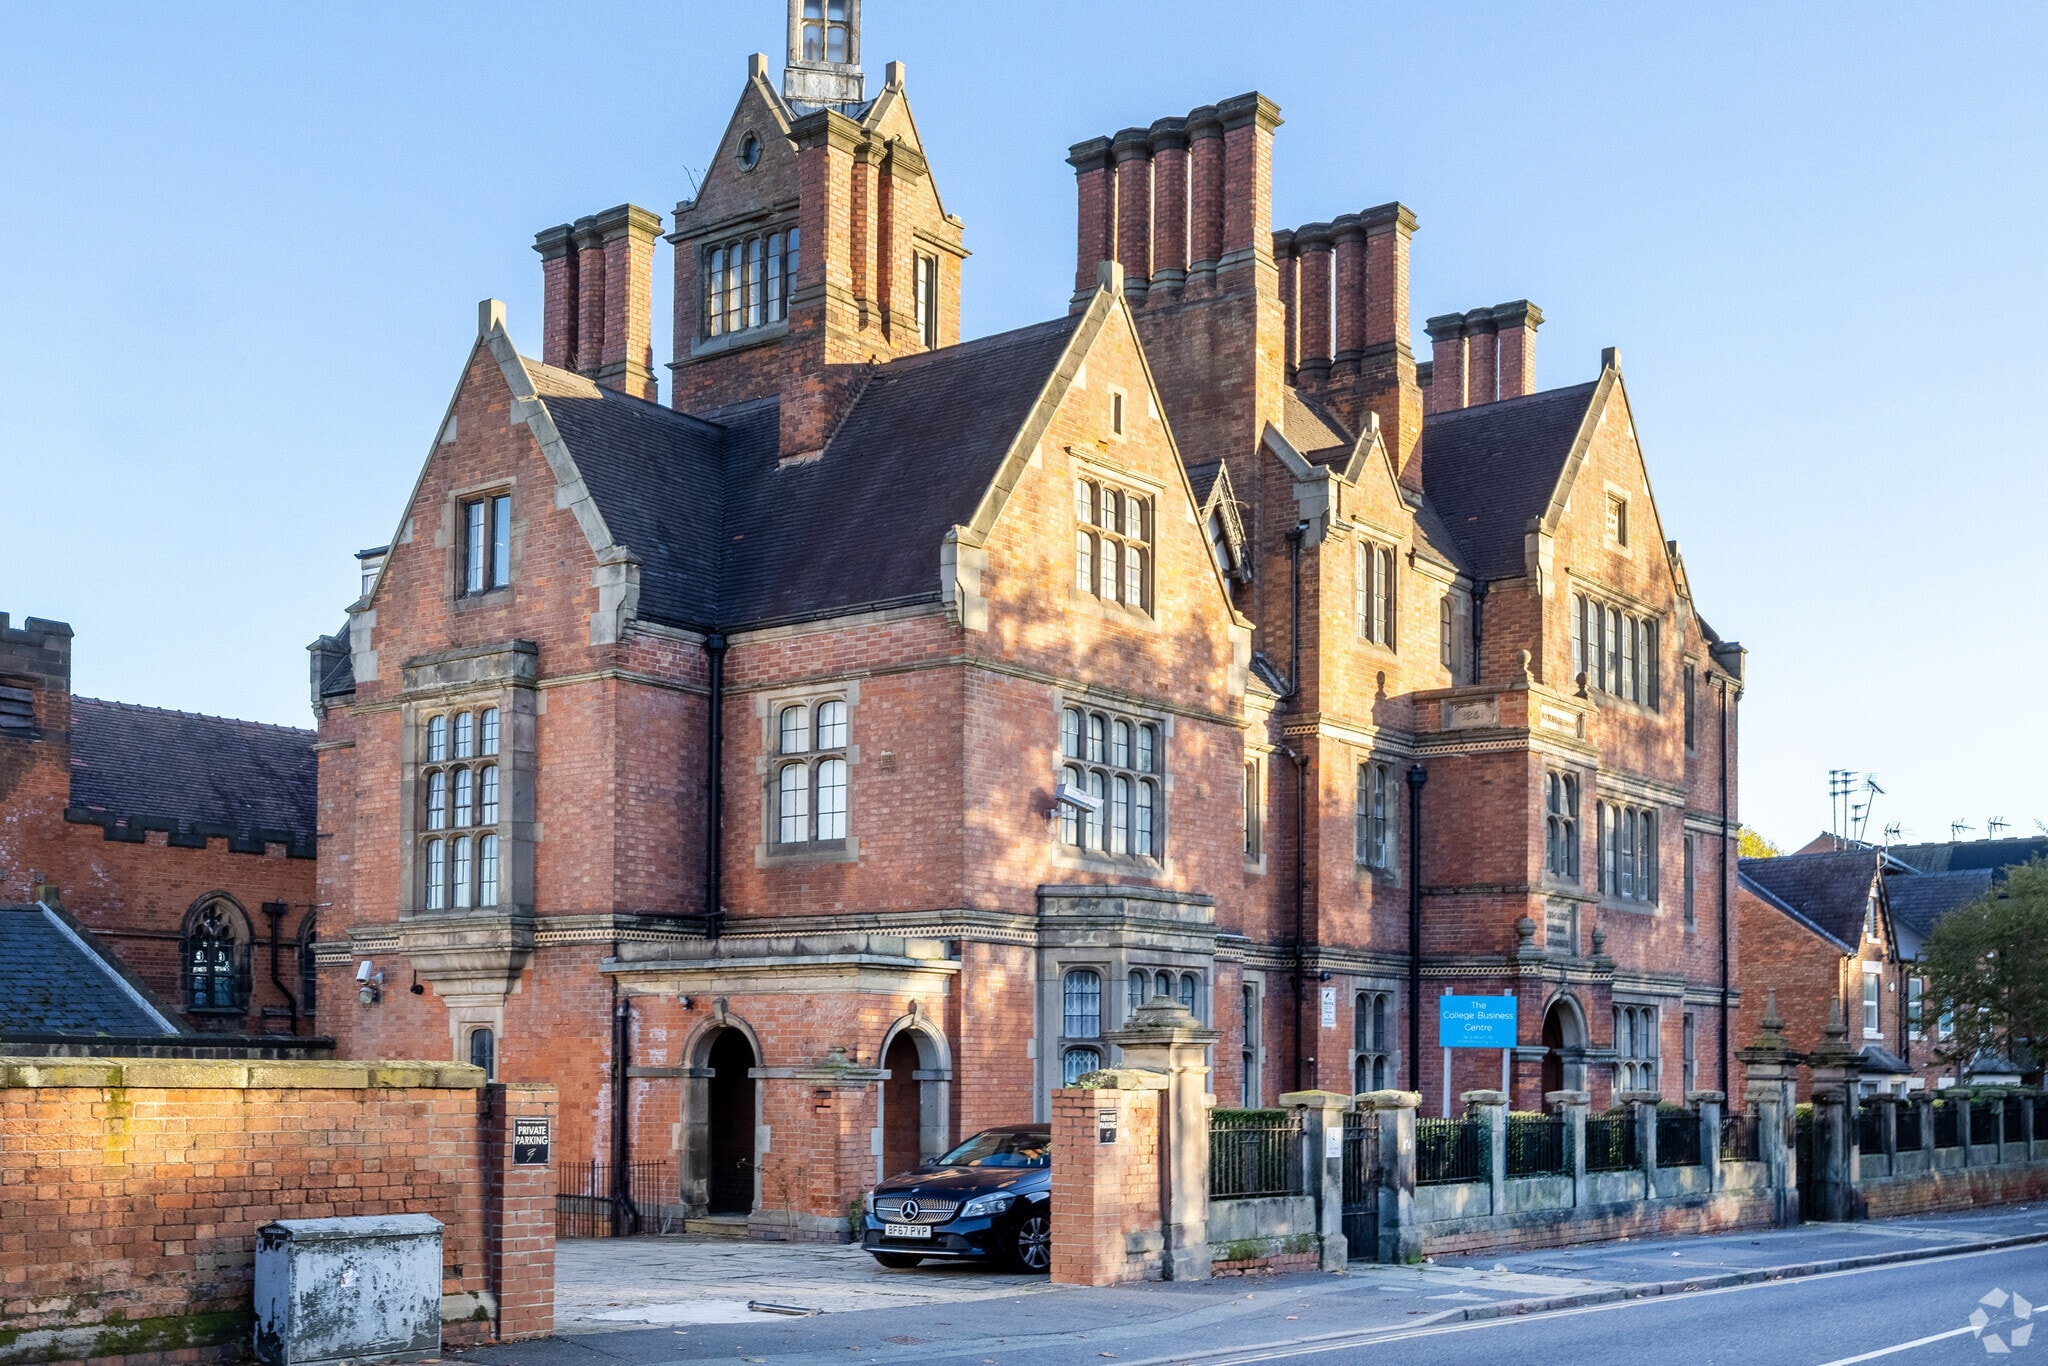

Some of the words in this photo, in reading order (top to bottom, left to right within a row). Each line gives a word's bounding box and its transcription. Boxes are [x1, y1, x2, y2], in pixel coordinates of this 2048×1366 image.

[1471, 1001, 1487, 1009] The
[1442, 1010, 1475, 1021] College
[1477, 1011, 1514, 1020] Business
[1464, 1023, 1493, 1032] Centre
[518, 1126, 547, 1135] PRIVATE
[515, 1135, 549, 1145] PARKING
[888, 1225, 908, 1236] BF67
[910, 1226, 928, 1236] PVP
